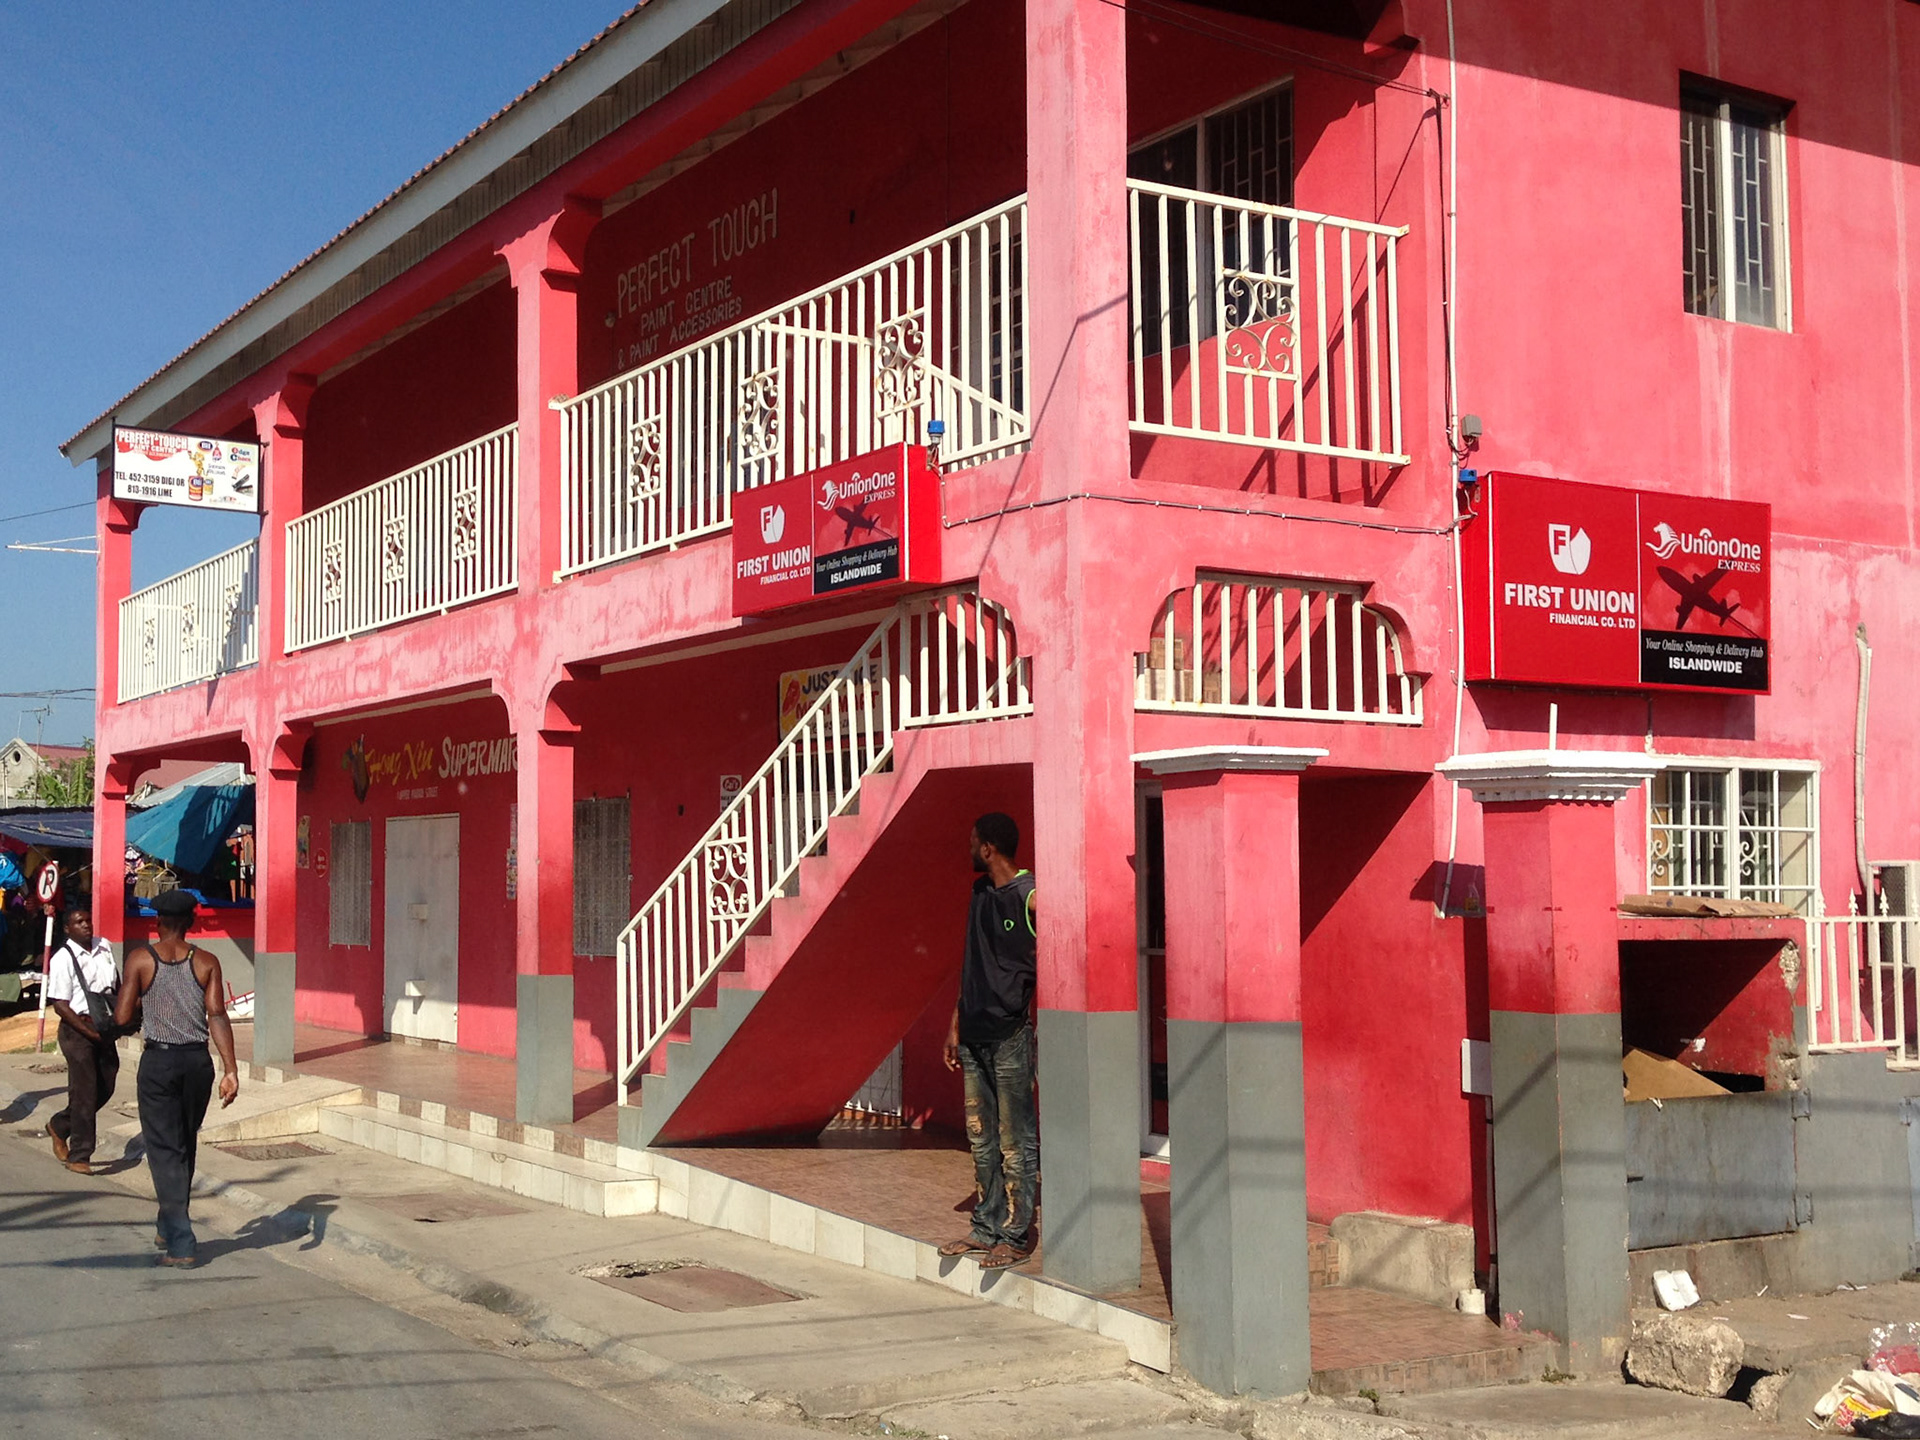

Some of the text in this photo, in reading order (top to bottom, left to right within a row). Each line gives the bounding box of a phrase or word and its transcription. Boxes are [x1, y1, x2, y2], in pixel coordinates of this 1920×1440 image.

[617, 187, 778, 319] PERFECT TOUCH
[641, 275, 732, 336] PAINT CENTRE
[618, 296, 742, 370] & PAINT ACCESSORIES
[119, 430, 154, 446] PERFECT
[159, 434, 188, 450] TOUCH
[129, 443, 150, 452] PAINT
[129, 472, 160, 484] 452-3159
[176, 478, 185, 487] OR
[839, 471, 896, 499] UnionOne
[128, 484, 156, 496] 813-1916
[158, 487, 172, 497] LIME
[863, 488, 896, 504] EXPRESS
[1680, 527, 1761, 561] UnionOne
[737, 545, 810, 579] FIRST UNION
[1717, 558, 1761, 573] EXPRESS
[760, 571, 789, 585] FINANCIAL
[799, 566, 811, 577] LTD
[830, 563, 882, 584] ISLANDWIDE
[1504, 582, 1635, 614] FIRST UNION
[1549, 612, 1599, 627] FINANCIAL
[1618, 617, 1636, 629] LTD
[1645, 637, 1764, 659] Your Online Shopping & Delivery Hub
[1669, 656, 1743, 674] ISLANDWIDE
[438, 736, 517, 778] SUPERMAR
